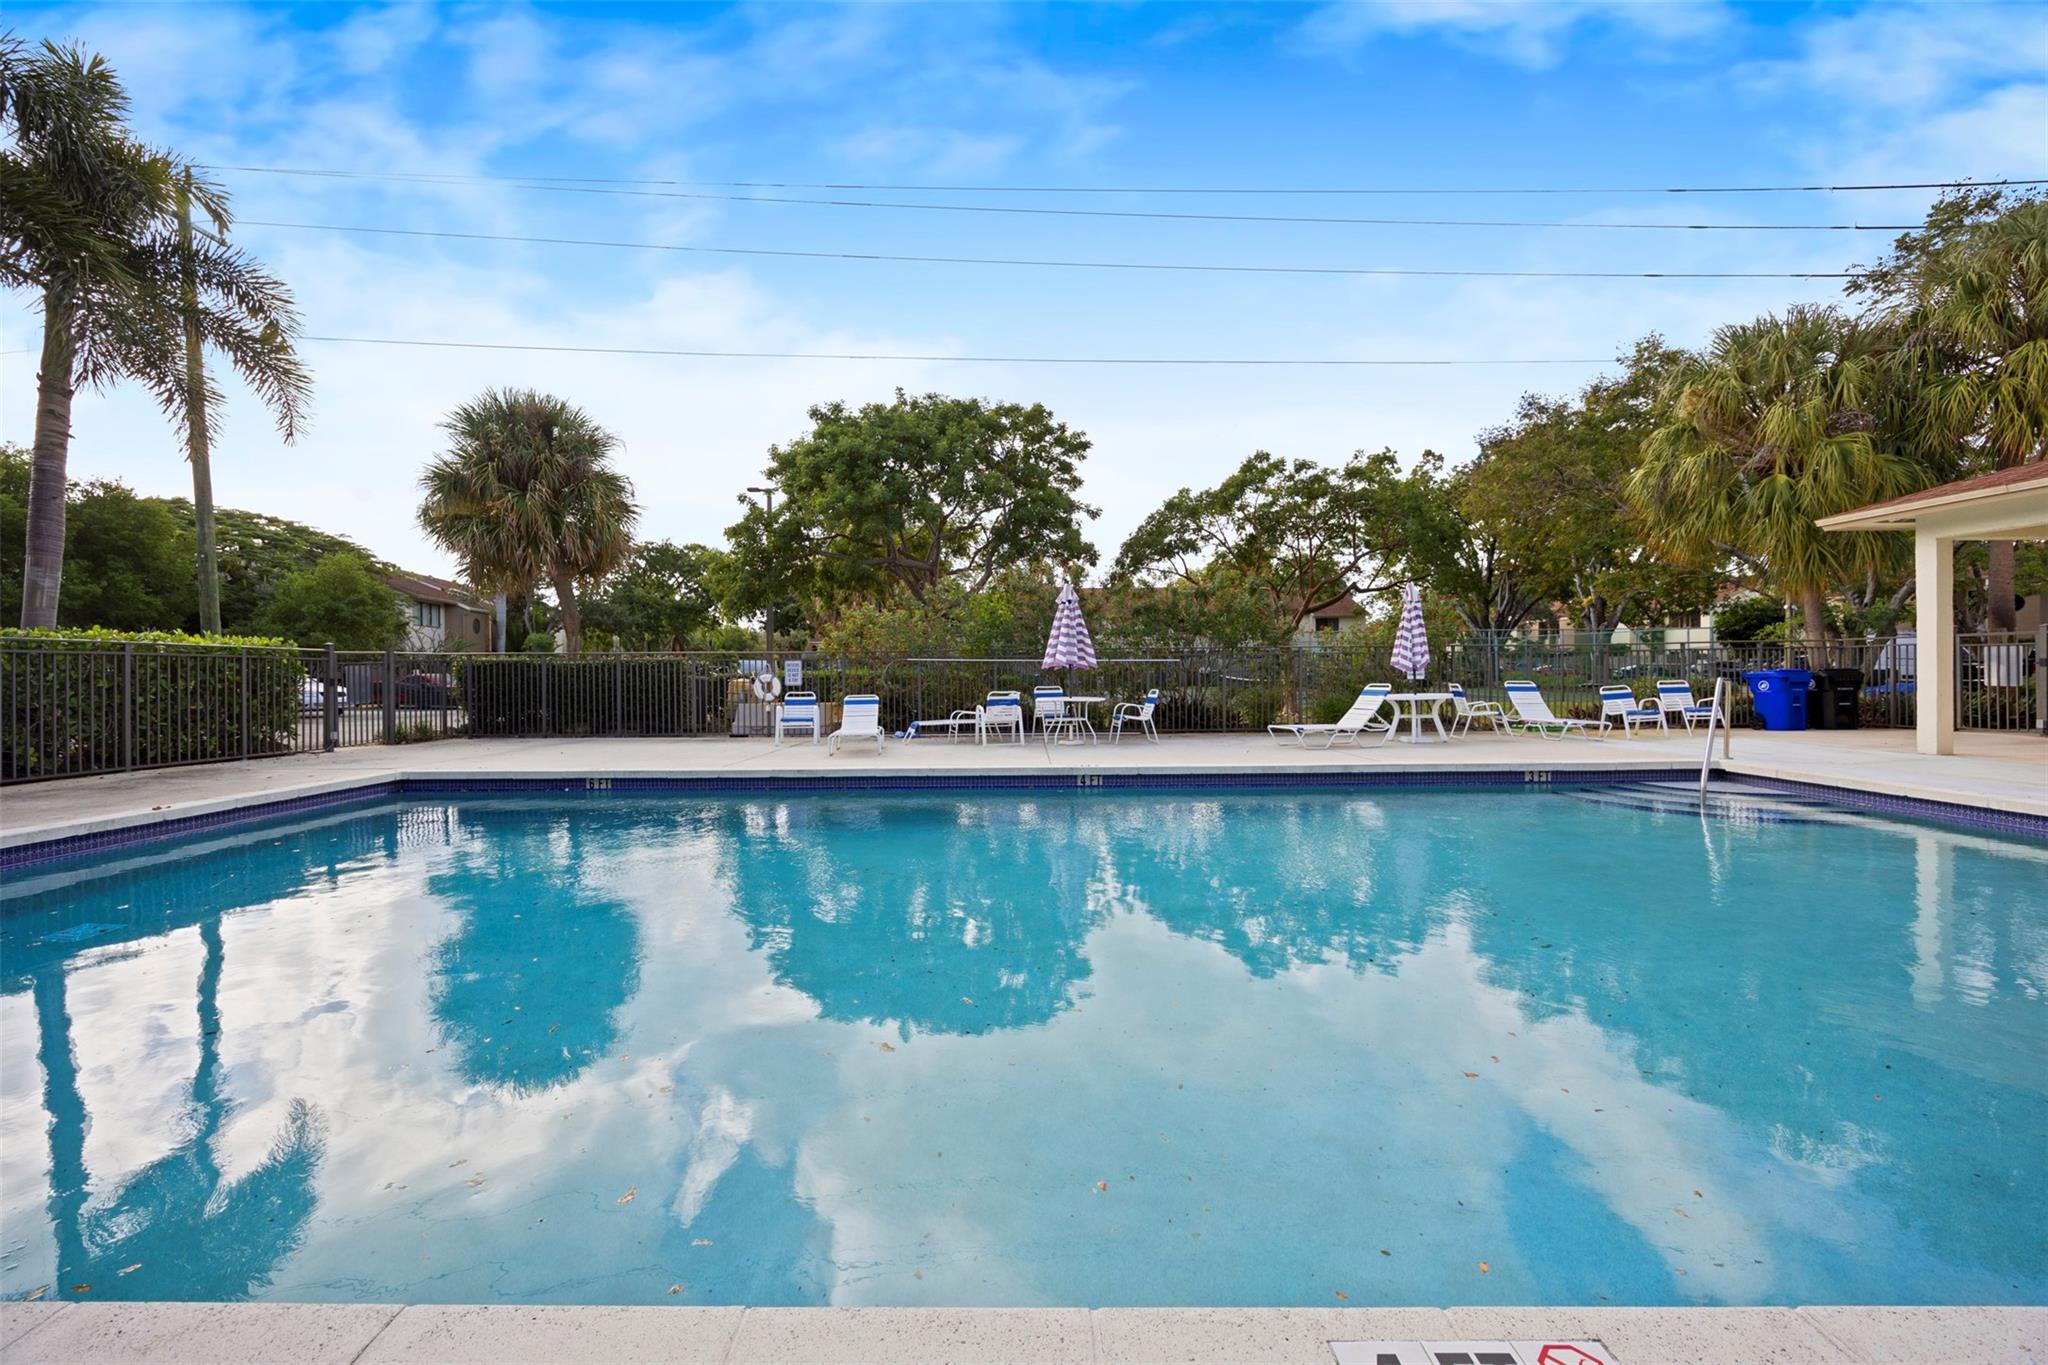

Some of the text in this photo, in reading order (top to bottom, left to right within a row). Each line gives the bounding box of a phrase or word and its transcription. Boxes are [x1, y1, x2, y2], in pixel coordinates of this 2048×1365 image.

[1081, 775, 1102, 786] 4 FT
[1529, 771, 1551, 783] 3 FT
[590, 778, 610, 789] 6 FT
